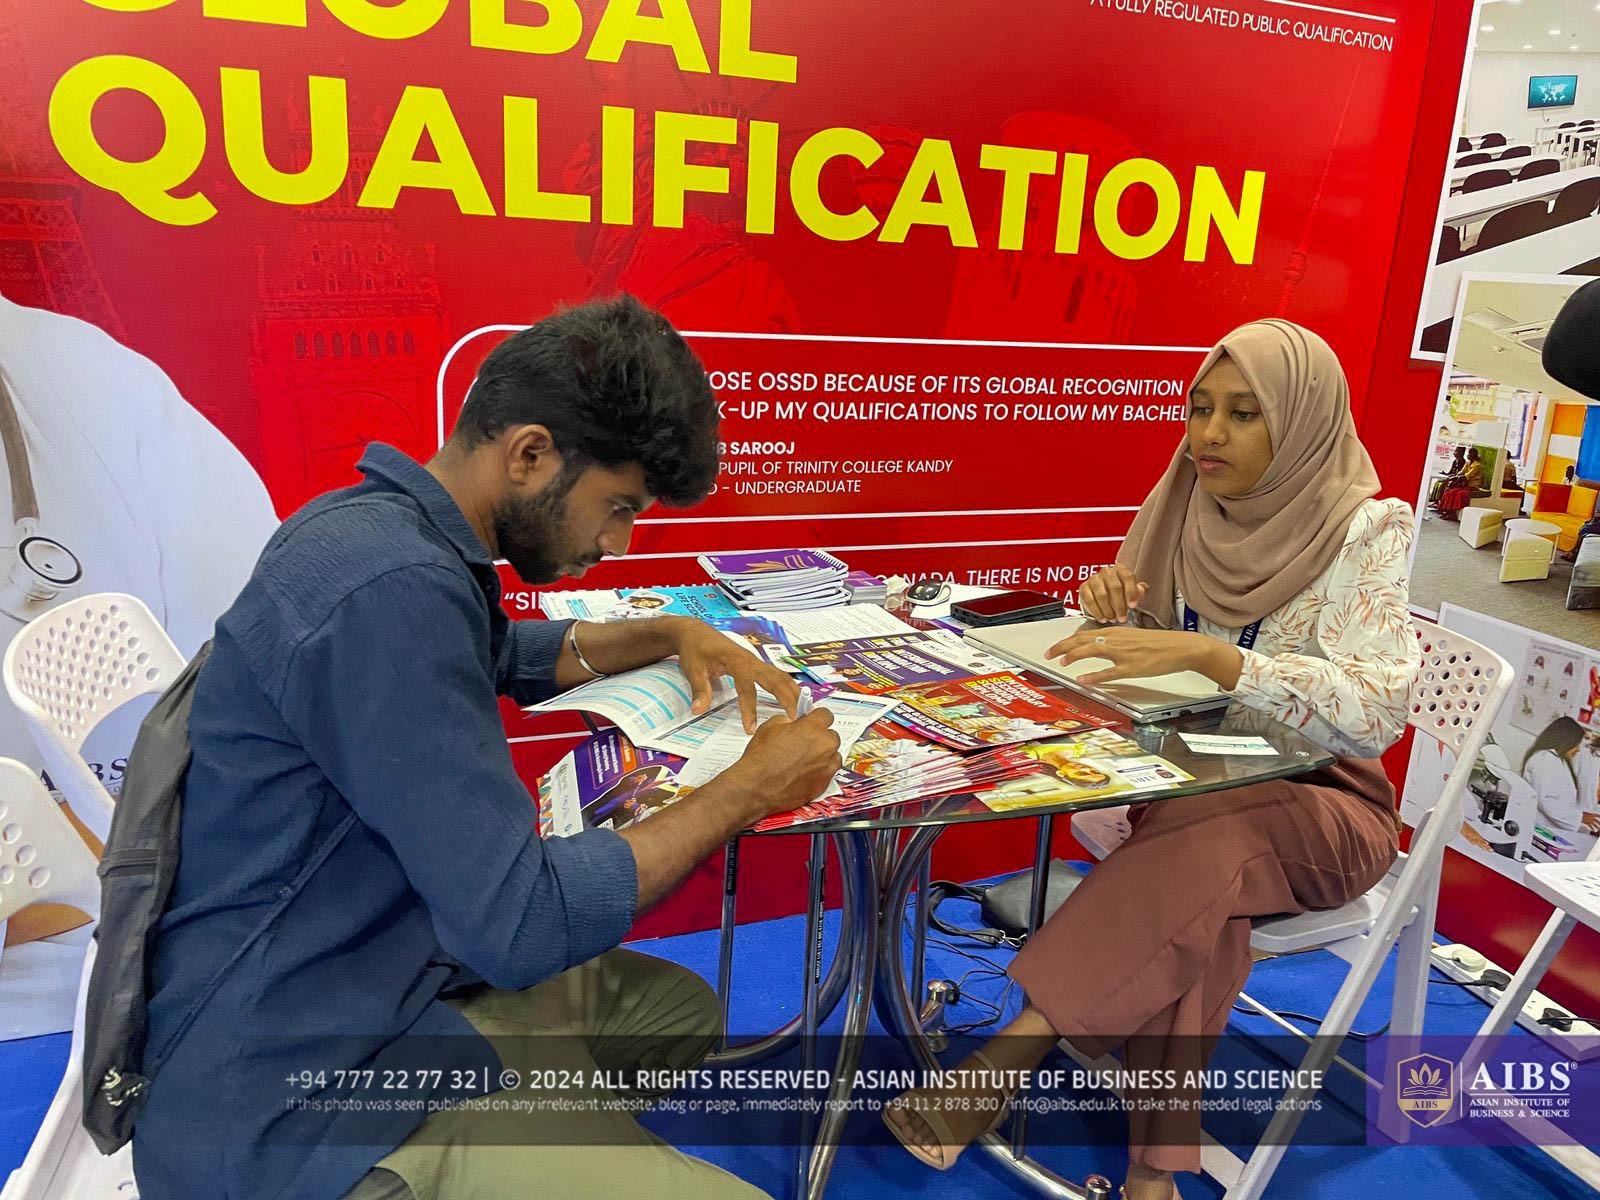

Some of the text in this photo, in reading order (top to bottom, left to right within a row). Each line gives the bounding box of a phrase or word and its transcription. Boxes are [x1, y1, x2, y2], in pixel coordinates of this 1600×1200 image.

[1154, 1, 1240, 28] REGULATED
[1242, 13, 1291, 36] PUBLIC
[1293, 21, 1394, 52] QUALIFICATION
[48, 55, 1266, 266] QUALIFICATION
[704, 371, 1184, 396] OSE OSSD BECAUSE OF ITS GLOBAL RECOGNITION
[775, 402, 808, 419] MY
[812, 402, 978, 422] QUALIFICATIONS
[983, 403, 1009, 420] TO
[1013, 403, 1088, 420] FOLLOW
[1091, 404, 1119, 421] MY
[730, 441, 795, 455] SAROOJ
[718, 459, 954, 475] PUPIL OF TRINITY COLLEGE KANDY
[735, 480, 862, 495] UNDERGRADUATE
[967, 569, 1022, 586] THERE
[1025, 567, 1042, 583] IS
[1046, 566, 1074, 582] NO
